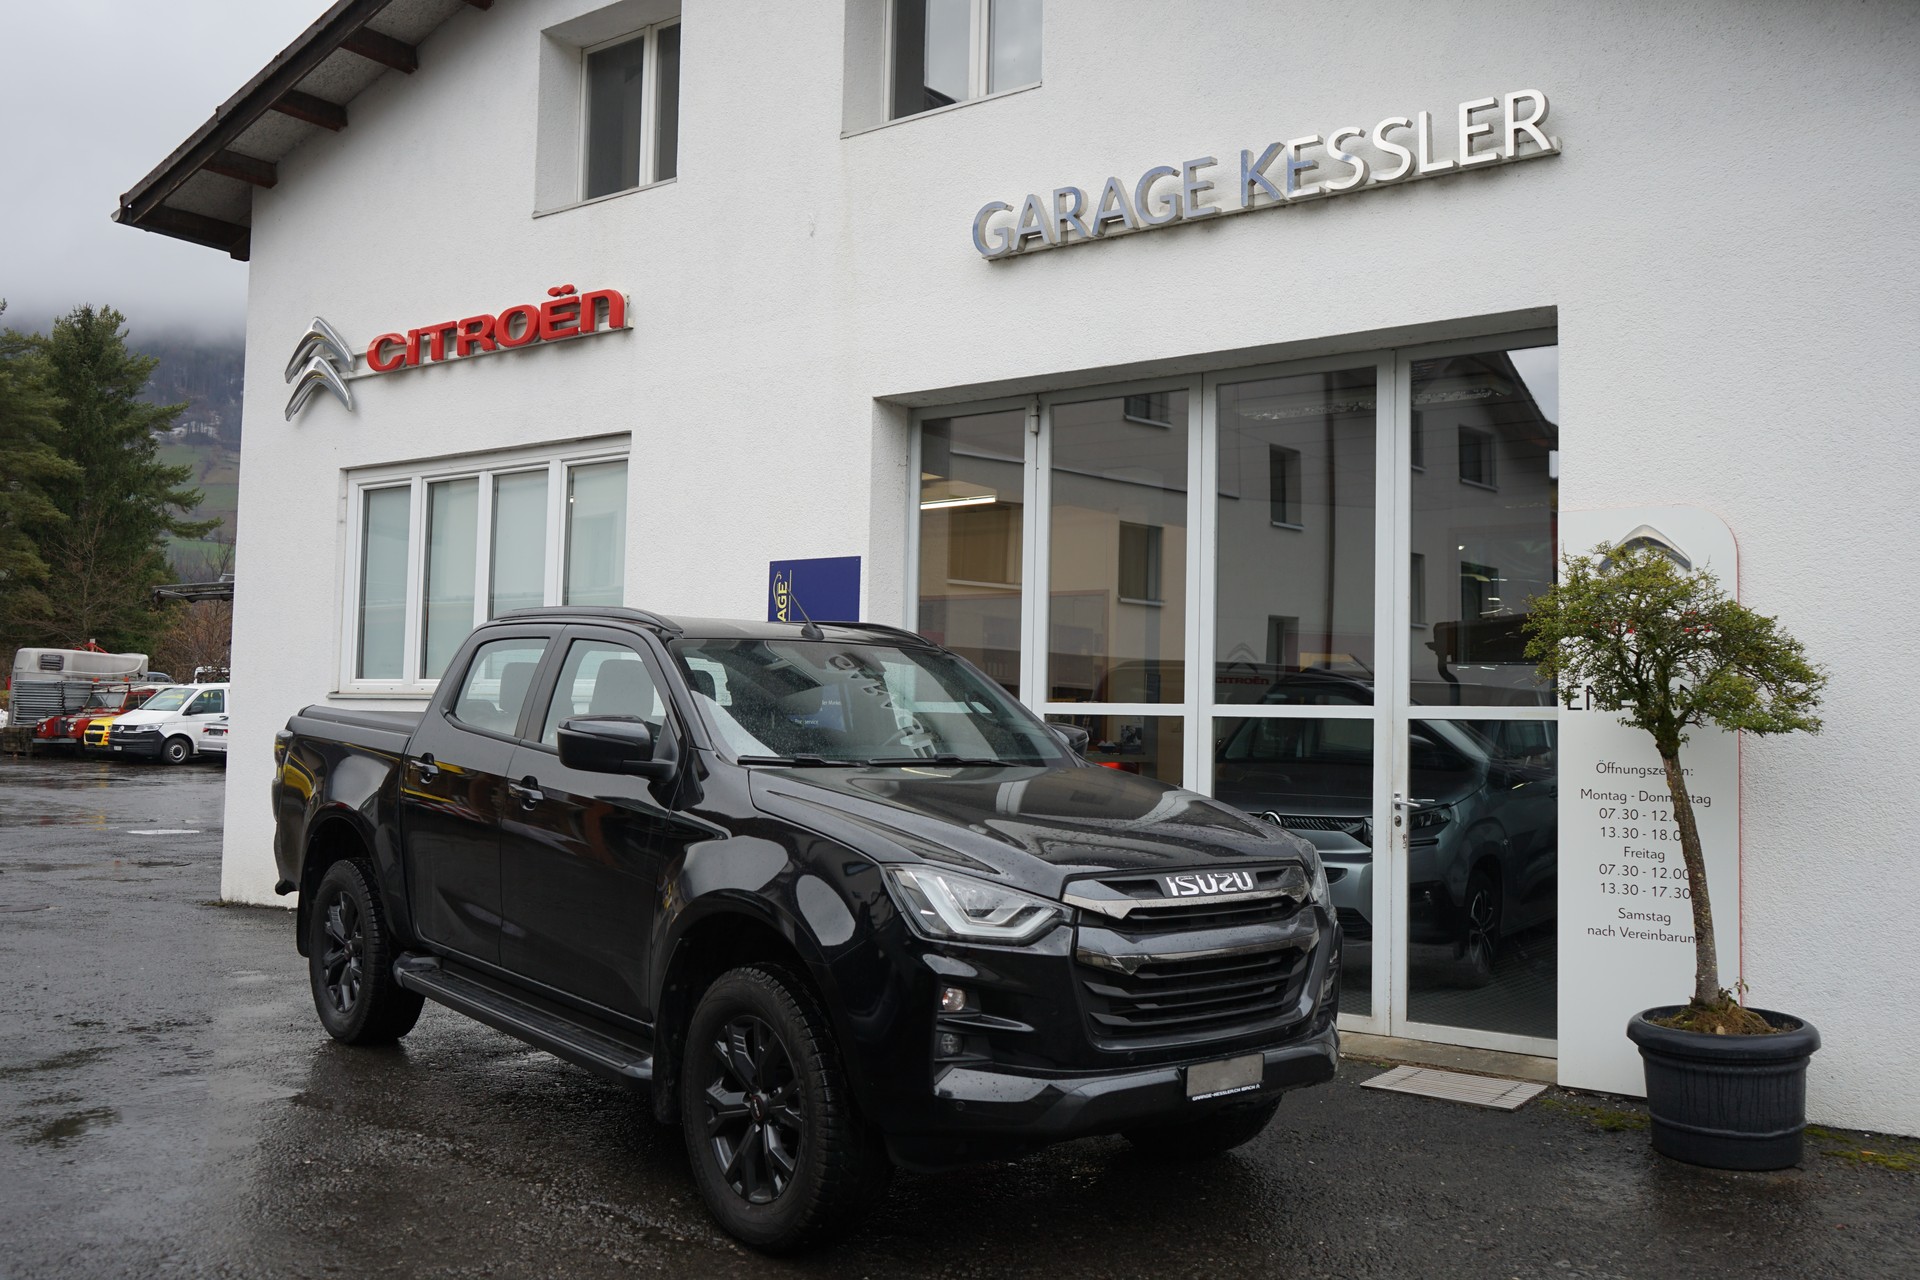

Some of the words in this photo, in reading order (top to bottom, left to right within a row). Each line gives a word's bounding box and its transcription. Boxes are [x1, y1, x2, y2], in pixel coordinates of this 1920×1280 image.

[972, 156, 1218, 258] GARAGE
[1241, 88, 1553, 210] KESSLER
[367, 284, 625, 372] CITROËN
[777, 581, 788, 622] AGE
[1595, 759, 1694, 779] Öffnungszen:
[1580, 788, 1627, 805] Montag
[1638, 790, 1712, 808] Donntag
[1599, 807, 1639, 820] 07.30
[1651, 810, 1676, 822] 12.
[1600, 826, 1639, 839] 13.30
[1651, 828, 1682, 842] 18.0
[1623, 846, 1665, 864] Freitag
[1599, 863, 1639, 877] 07.30
[1165, 871, 1254, 896] ISUZU
[1600, 882, 1639, 896] 13.30
[1651, 886, 1692, 899] 17.30
[1618, 907, 1671, 926] Samstag
[1587, 924, 1616, 937] nach
[1619, 926, 1696, 944] Vereinbarun
